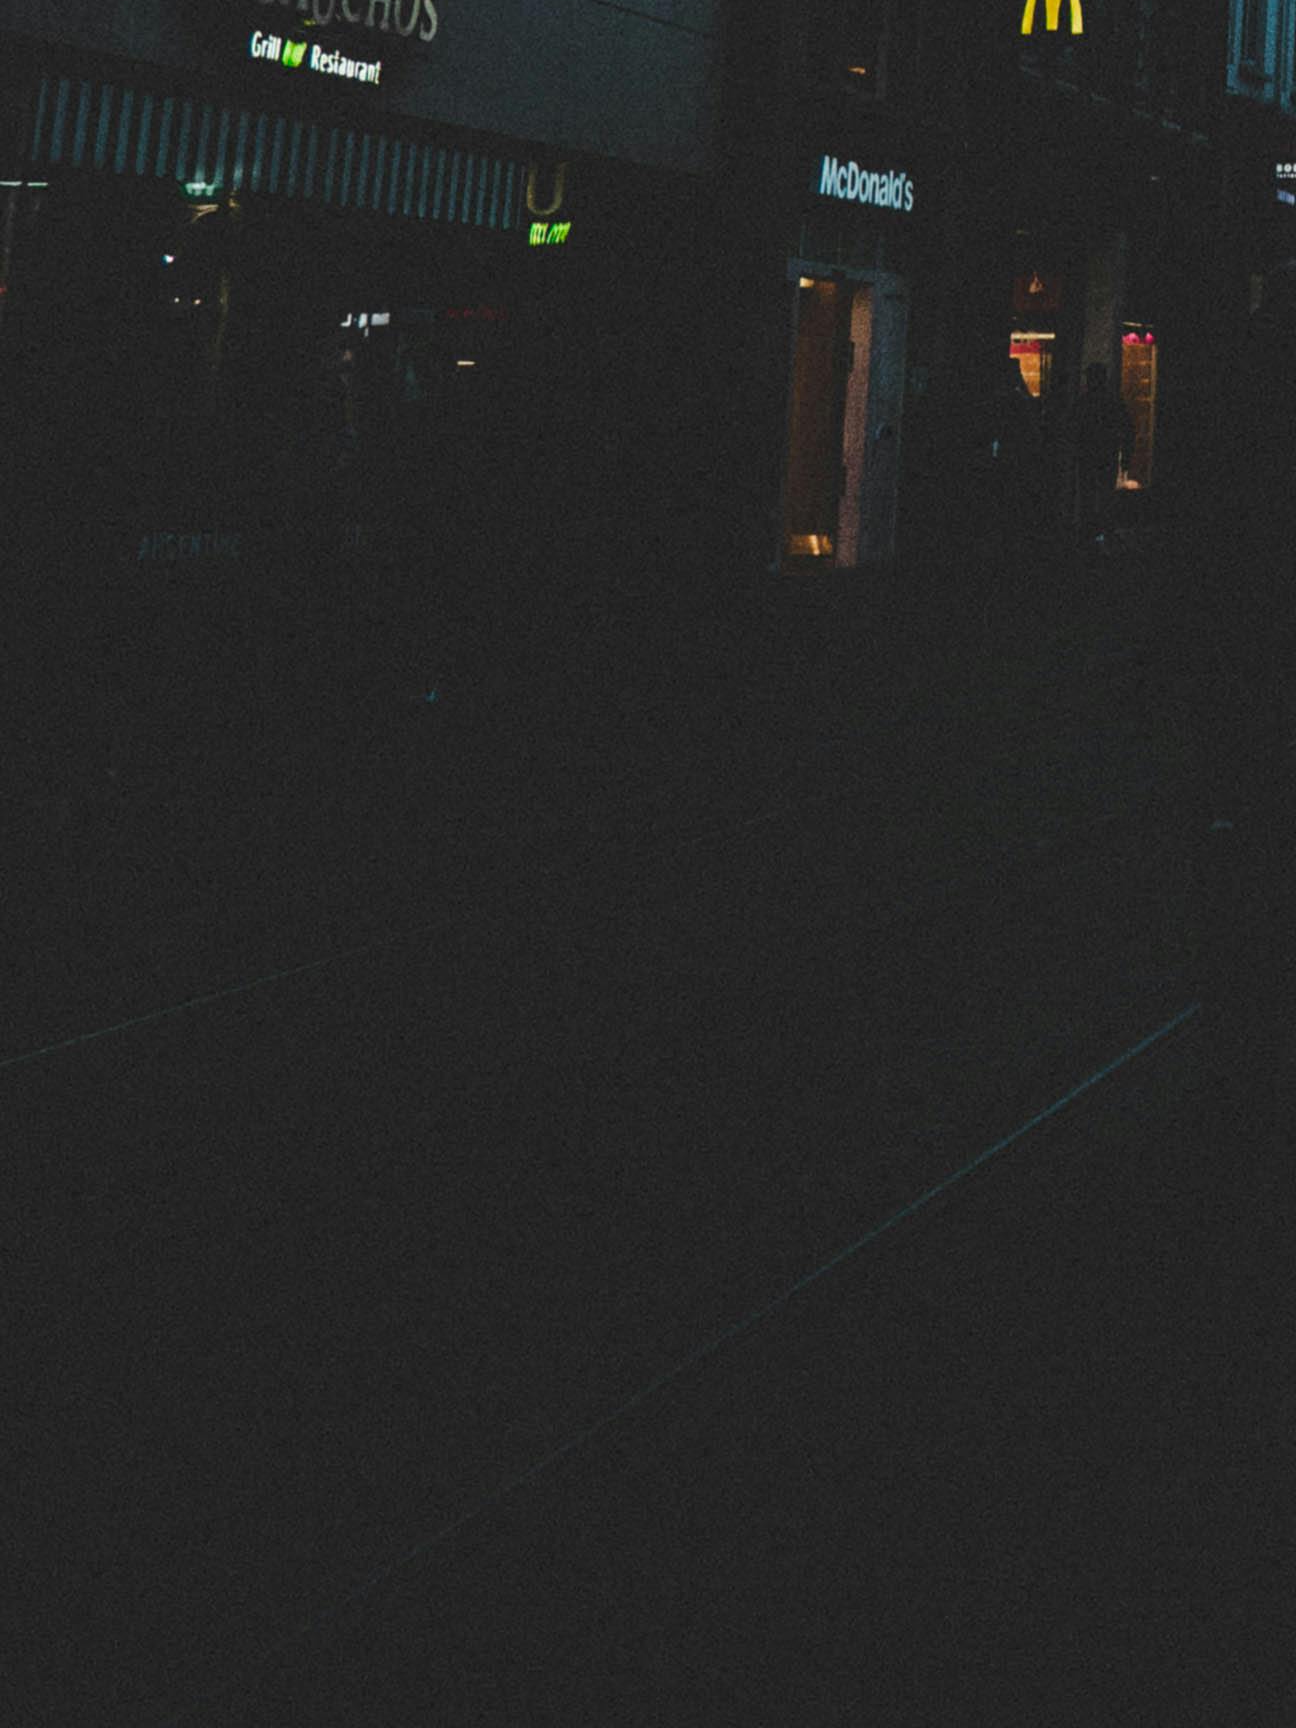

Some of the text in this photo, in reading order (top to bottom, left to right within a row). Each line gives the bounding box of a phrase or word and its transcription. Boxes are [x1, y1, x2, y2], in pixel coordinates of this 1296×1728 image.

[250, 30, 383, 85] Grill Restaurant
[819, 154, 914, 212] McDonald's
